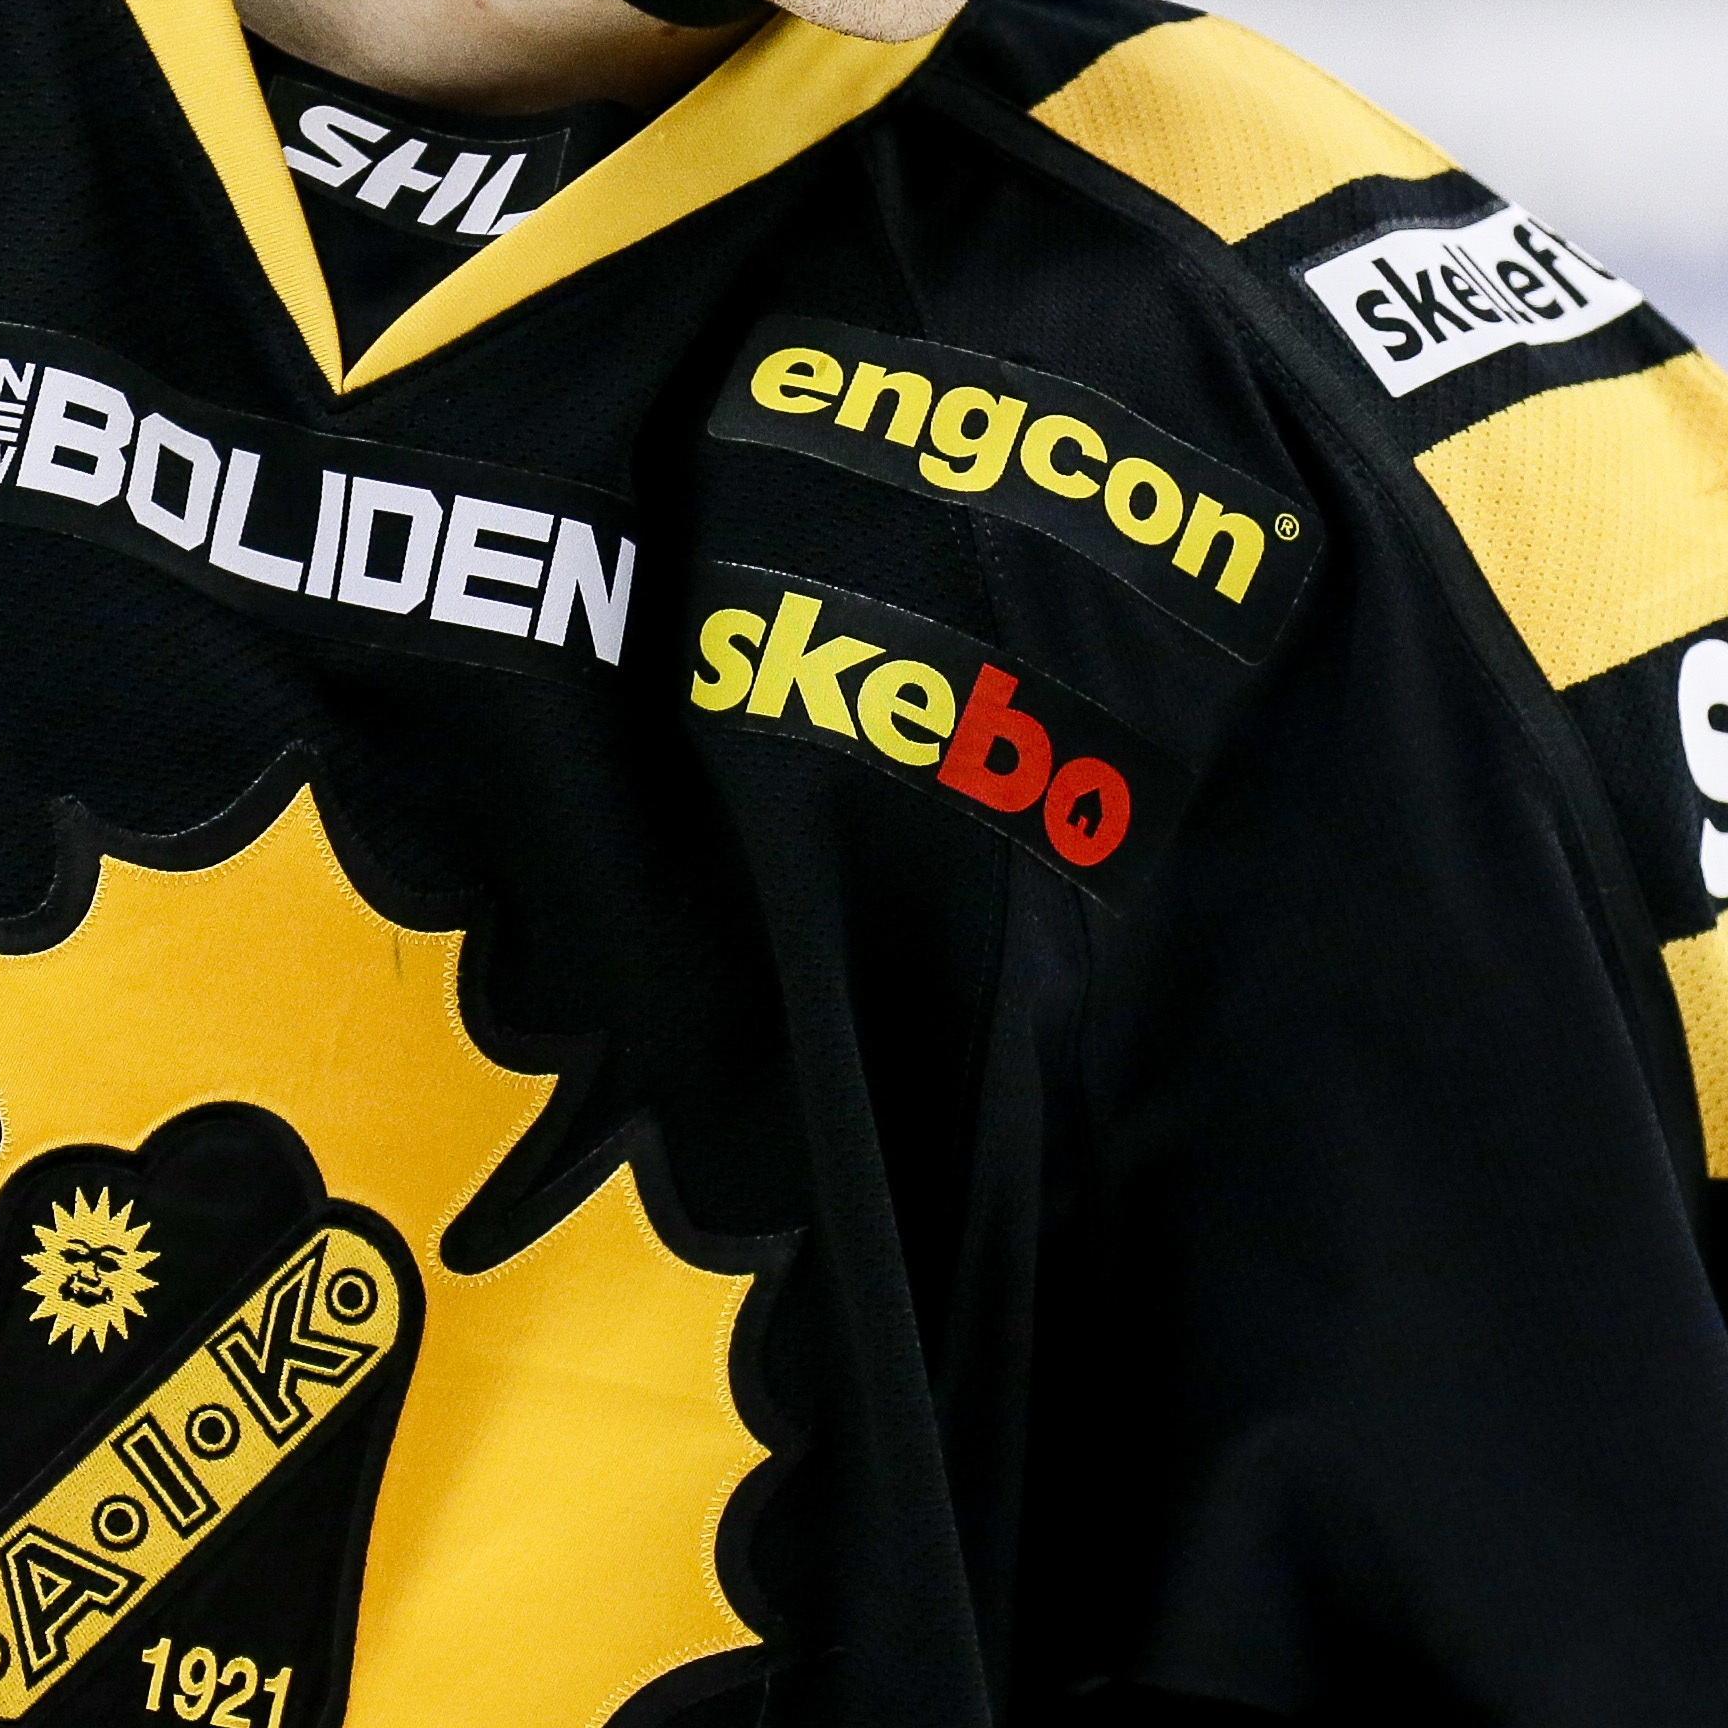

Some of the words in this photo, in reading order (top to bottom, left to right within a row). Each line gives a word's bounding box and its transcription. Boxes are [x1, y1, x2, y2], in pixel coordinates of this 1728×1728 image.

[282, 105, 538, 236] SHL
[16, 366, 636, 667] BOLIDEN
[690, 591, 1131, 867] skebo
[140, 1637, 293, 1728] 1921
